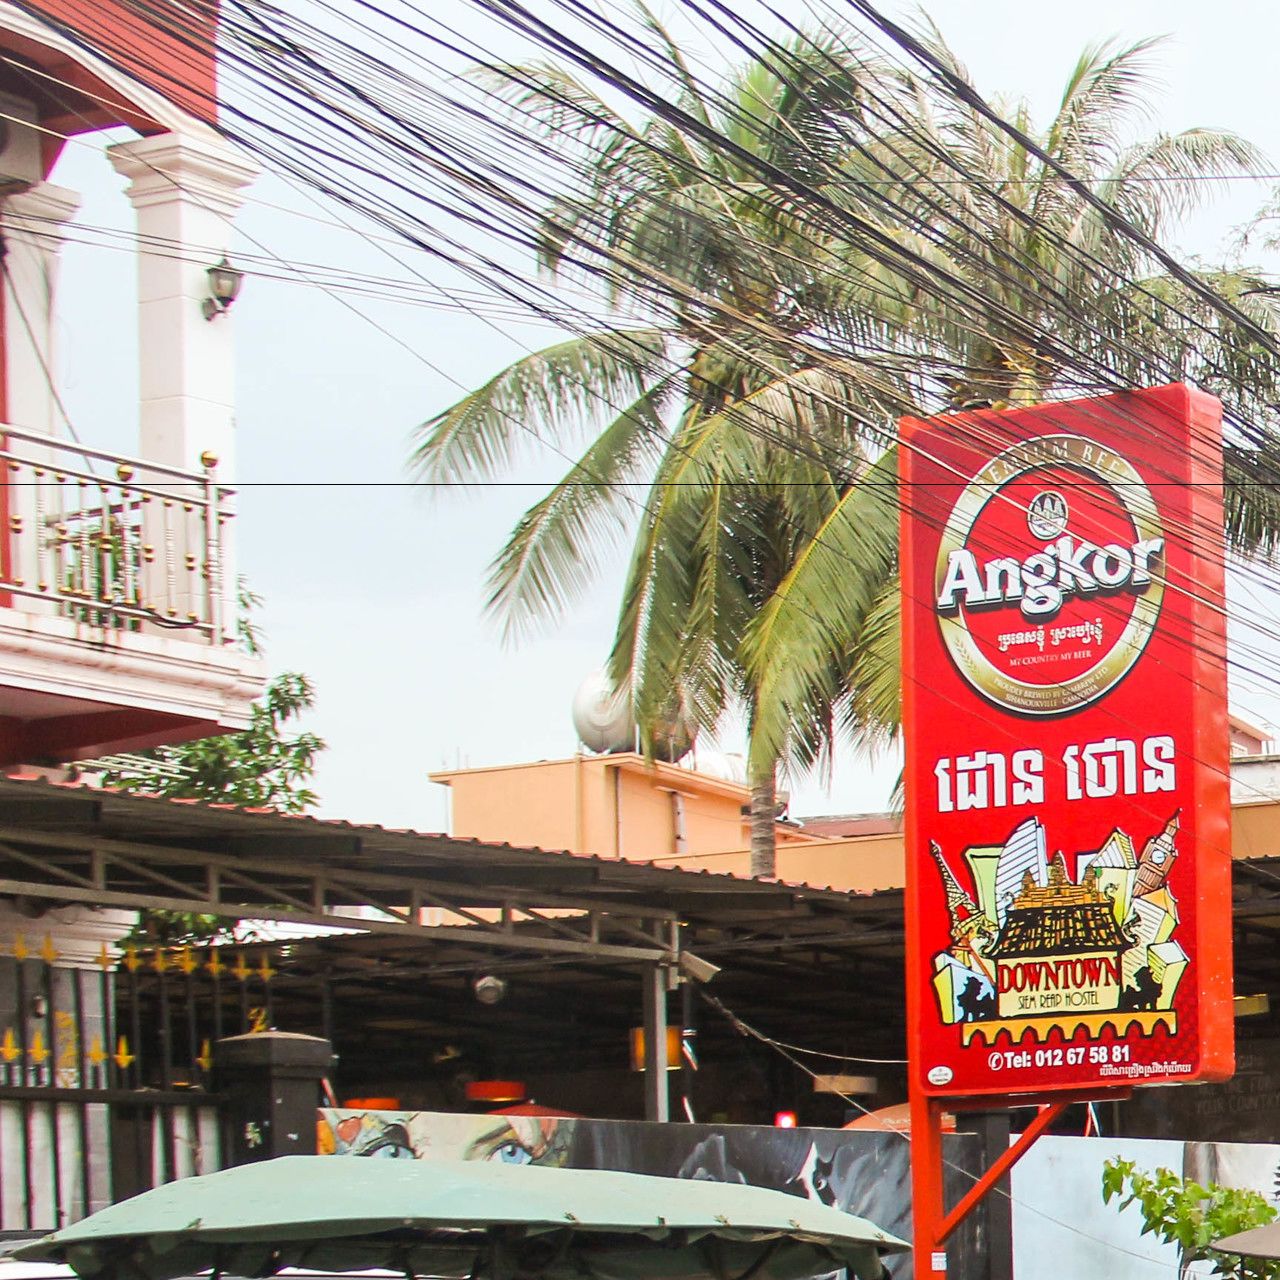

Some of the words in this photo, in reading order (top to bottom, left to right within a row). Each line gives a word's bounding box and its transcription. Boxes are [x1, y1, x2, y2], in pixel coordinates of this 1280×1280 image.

[938, 537, 1164, 614] Angkor
[1074, 650, 1092, 658] BEER
[998, 957, 1120, 993] DOWNTOWN
[1018, 995, 1036, 1009] SIEM
[1040, 993, 1062, 1008] REAP
[1065, 991, 1099, 1007] HOSTEL
[1004, 1052, 1031, 1069] Tel:
[1035, 1049, 1063, 1067] 012
[1066, 1048, 1086, 1065] 67
[1088, 1046, 1108, 1064] 58
[1111, 1044, 1131, 1063] 81
